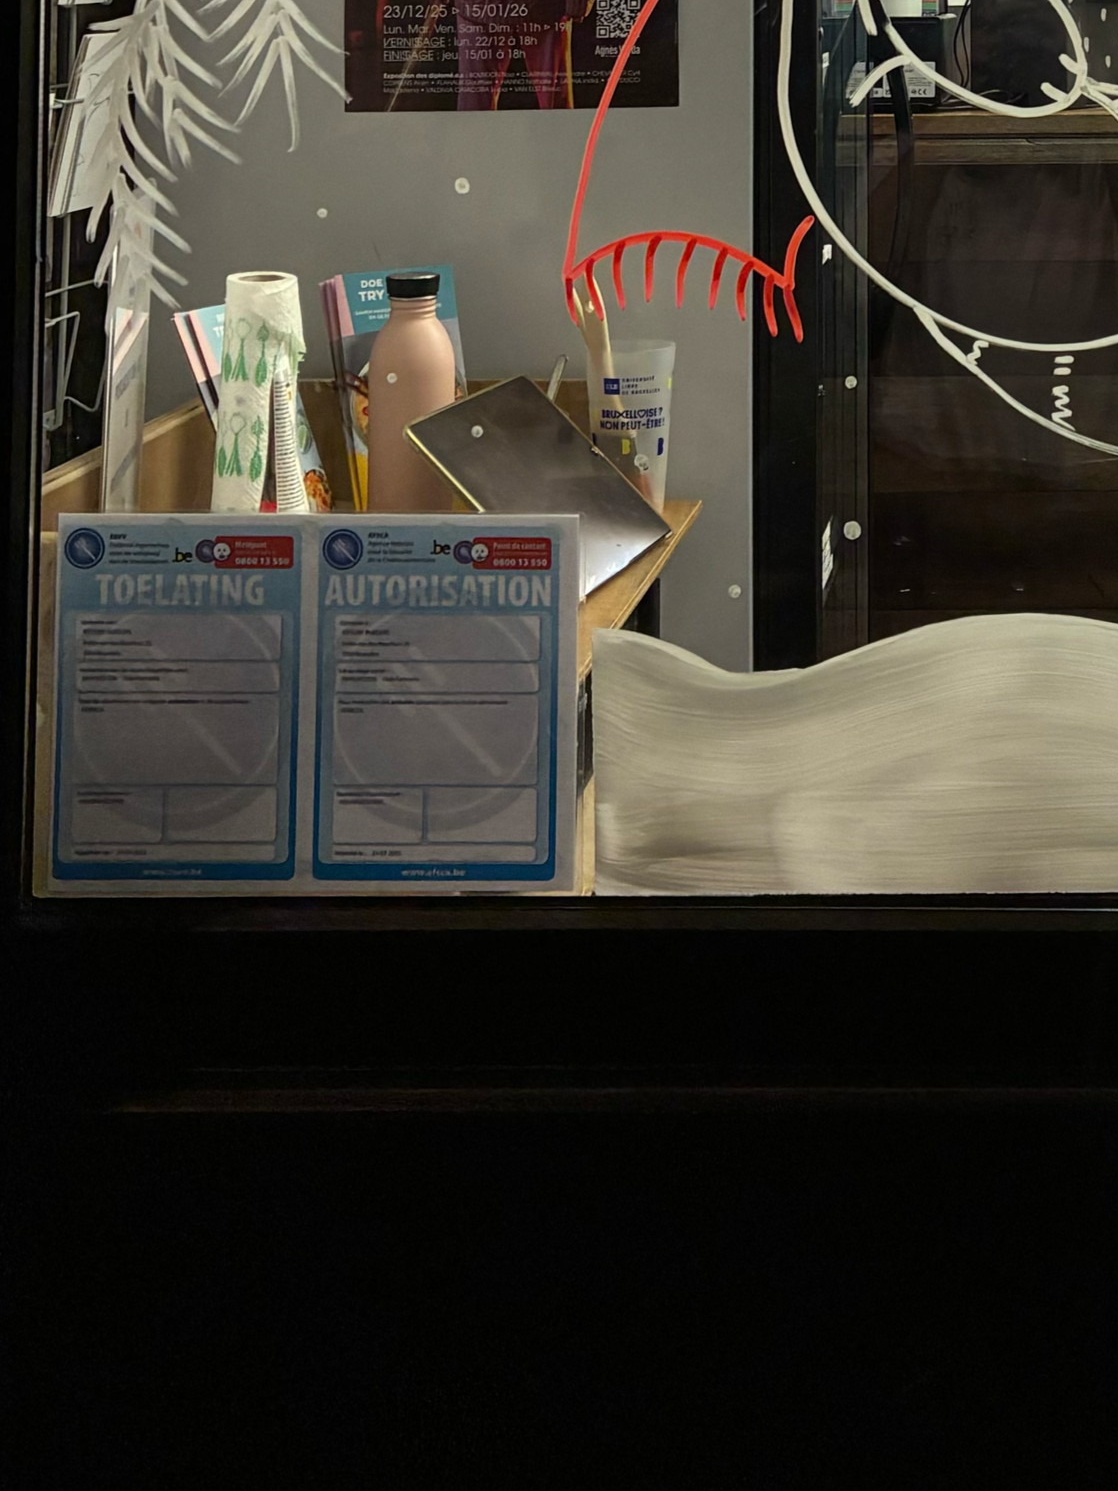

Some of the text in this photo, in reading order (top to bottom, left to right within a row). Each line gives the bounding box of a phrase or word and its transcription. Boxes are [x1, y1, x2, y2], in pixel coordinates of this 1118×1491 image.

[383, 4, 528, 19] 23/12/25 15/01/26
[383, 24, 405, 34] Lun.
[522, 22, 541, 32] 11h
[384, 37, 445, 48] VERNISSAGE
[475, 37, 505, 47] 22/12
[520, 36, 538, 46] 18h
[384, 50, 434, 62] FINISSAGE
[466, 50, 492, 59] 15/01
[509, 49, 526, 58] 18h
[361, 279, 383, 288] DOE
[358, 290, 384, 302] TRY
[600, 421, 619, 430] NON
[95, 574, 264, 606] TOELATING
[324, 575, 551, 607] AUTORISATION
